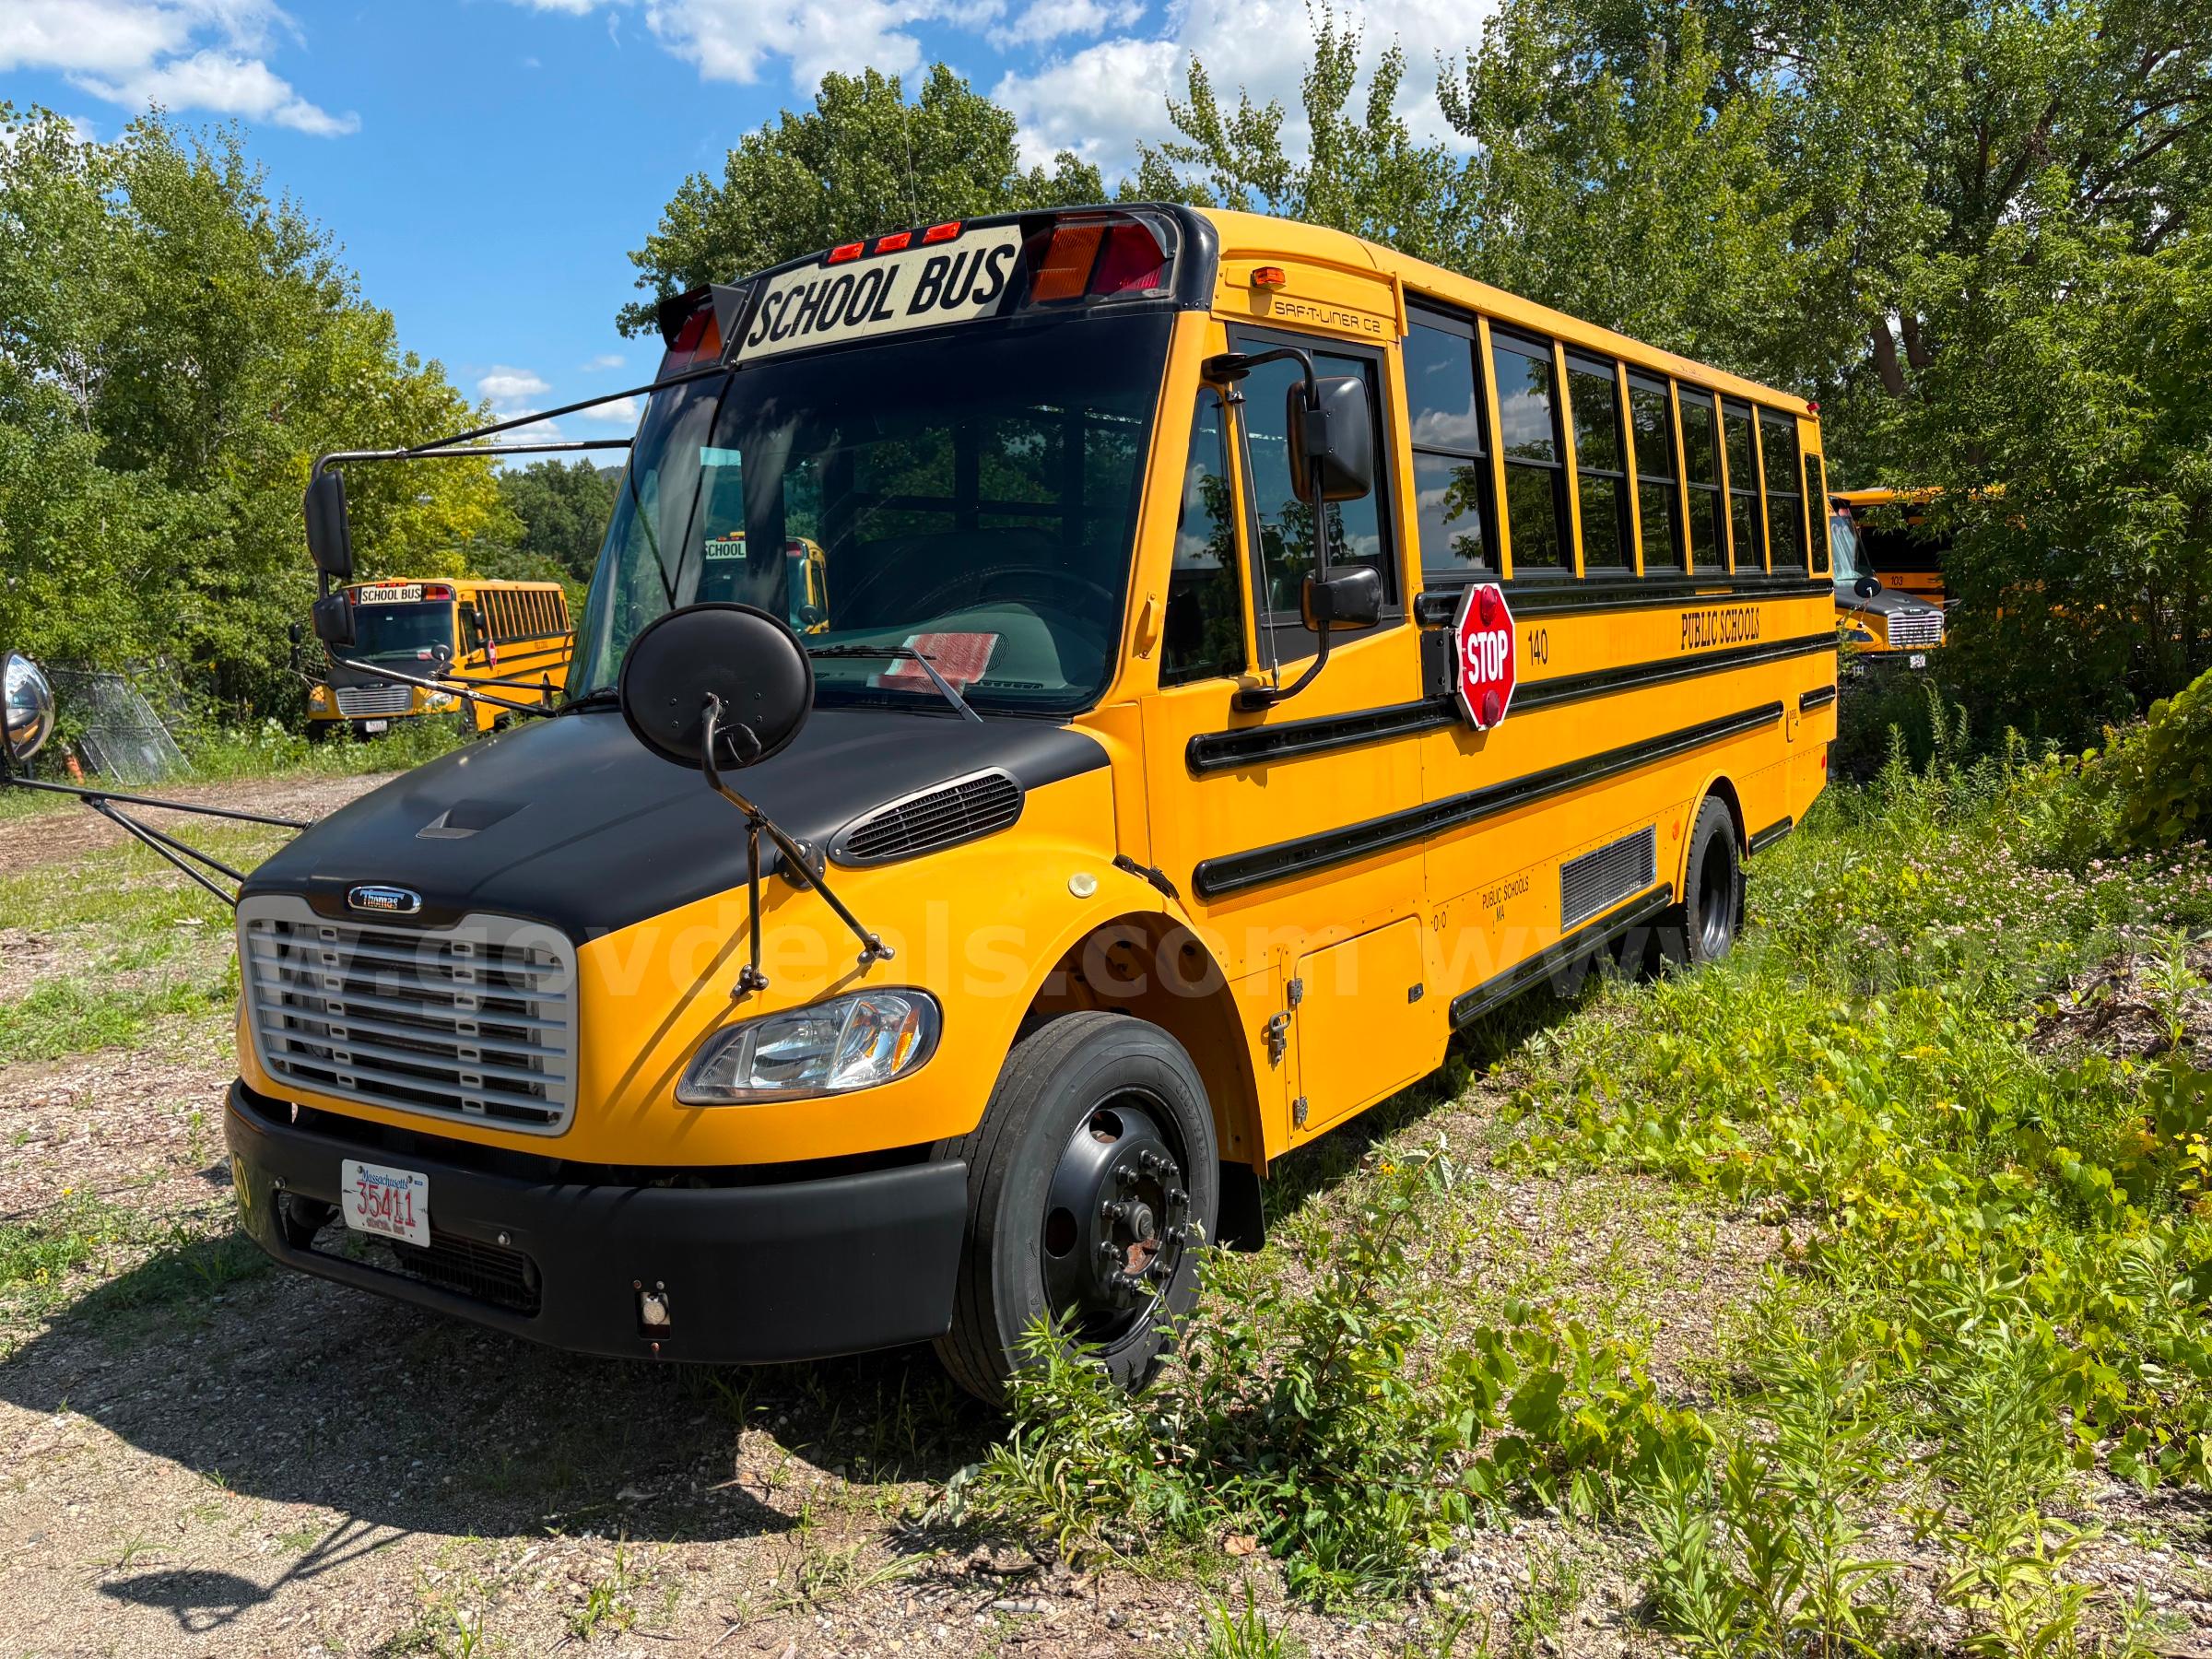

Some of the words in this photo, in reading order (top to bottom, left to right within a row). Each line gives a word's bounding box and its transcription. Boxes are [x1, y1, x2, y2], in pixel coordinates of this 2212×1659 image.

[747, 265, 900, 347] SCHOOL
[906, 243, 1016, 316] BUS
[1364, 318, 1381, 333] C2
[362, 589, 398, 602] SCHOOL
[401, 588, 421, 600] BUS
[1681, 610, 1718, 650] PUBLIC
[1720, 606, 1759, 644] SCHOOLS
[1467, 629, 1508, 684] STOP
[1528, 629, 1548, 665] 140
[359, 889, 405, 910] Thomas
[1482, 888, 1502, 910] PUBLIC
[1503, 876, 1529, 903] SCHOOLS
[1496, 905, 1505, 922] MA
[362, 1170, 408, 1190] Massachusetts
[357, 1181, 416, 1228] 35411
